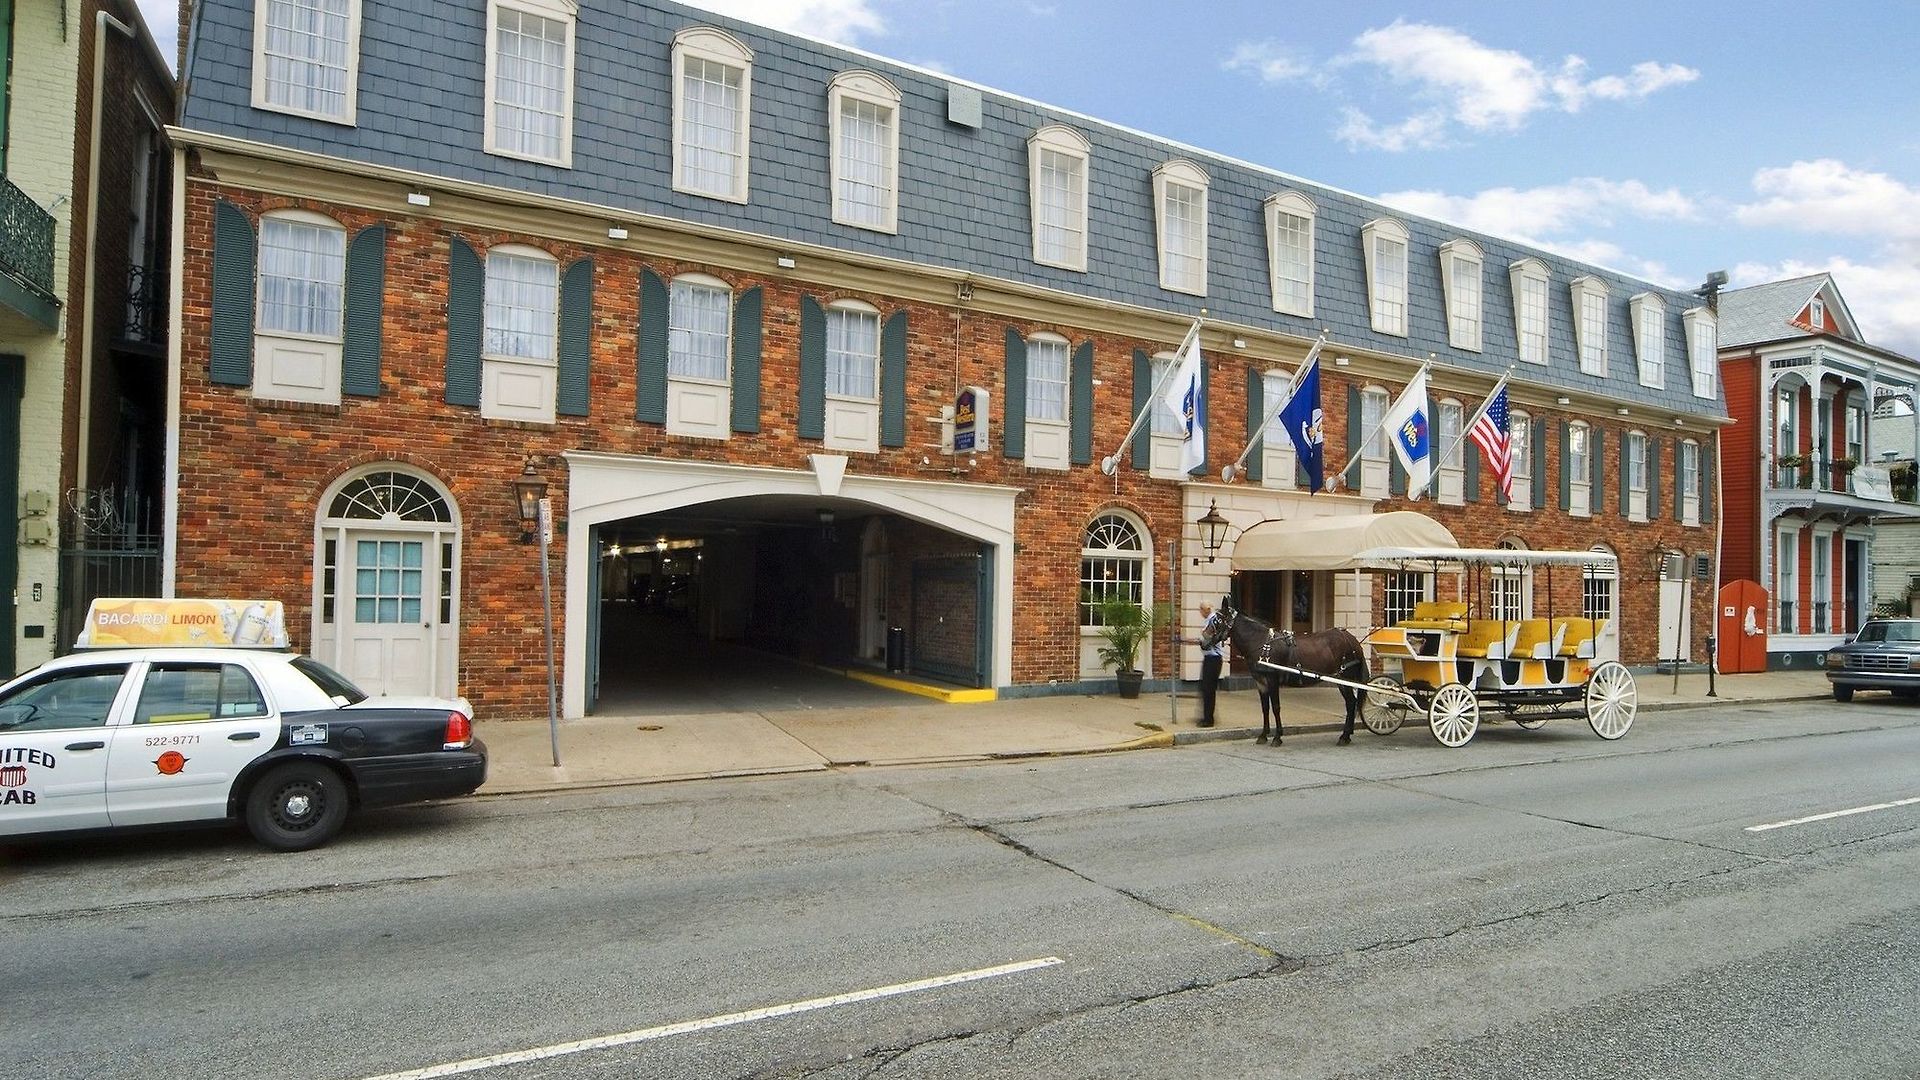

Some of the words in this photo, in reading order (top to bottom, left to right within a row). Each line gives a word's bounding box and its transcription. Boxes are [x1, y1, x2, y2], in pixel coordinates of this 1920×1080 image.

[98, 613, 168, 625] BACARDI
[172, 614, 217, 625] LIMON
[145, 735, 200, 747] 522-9771
[0, 748, 56, 769] ITED
[0, 789, 36, 805] AB
